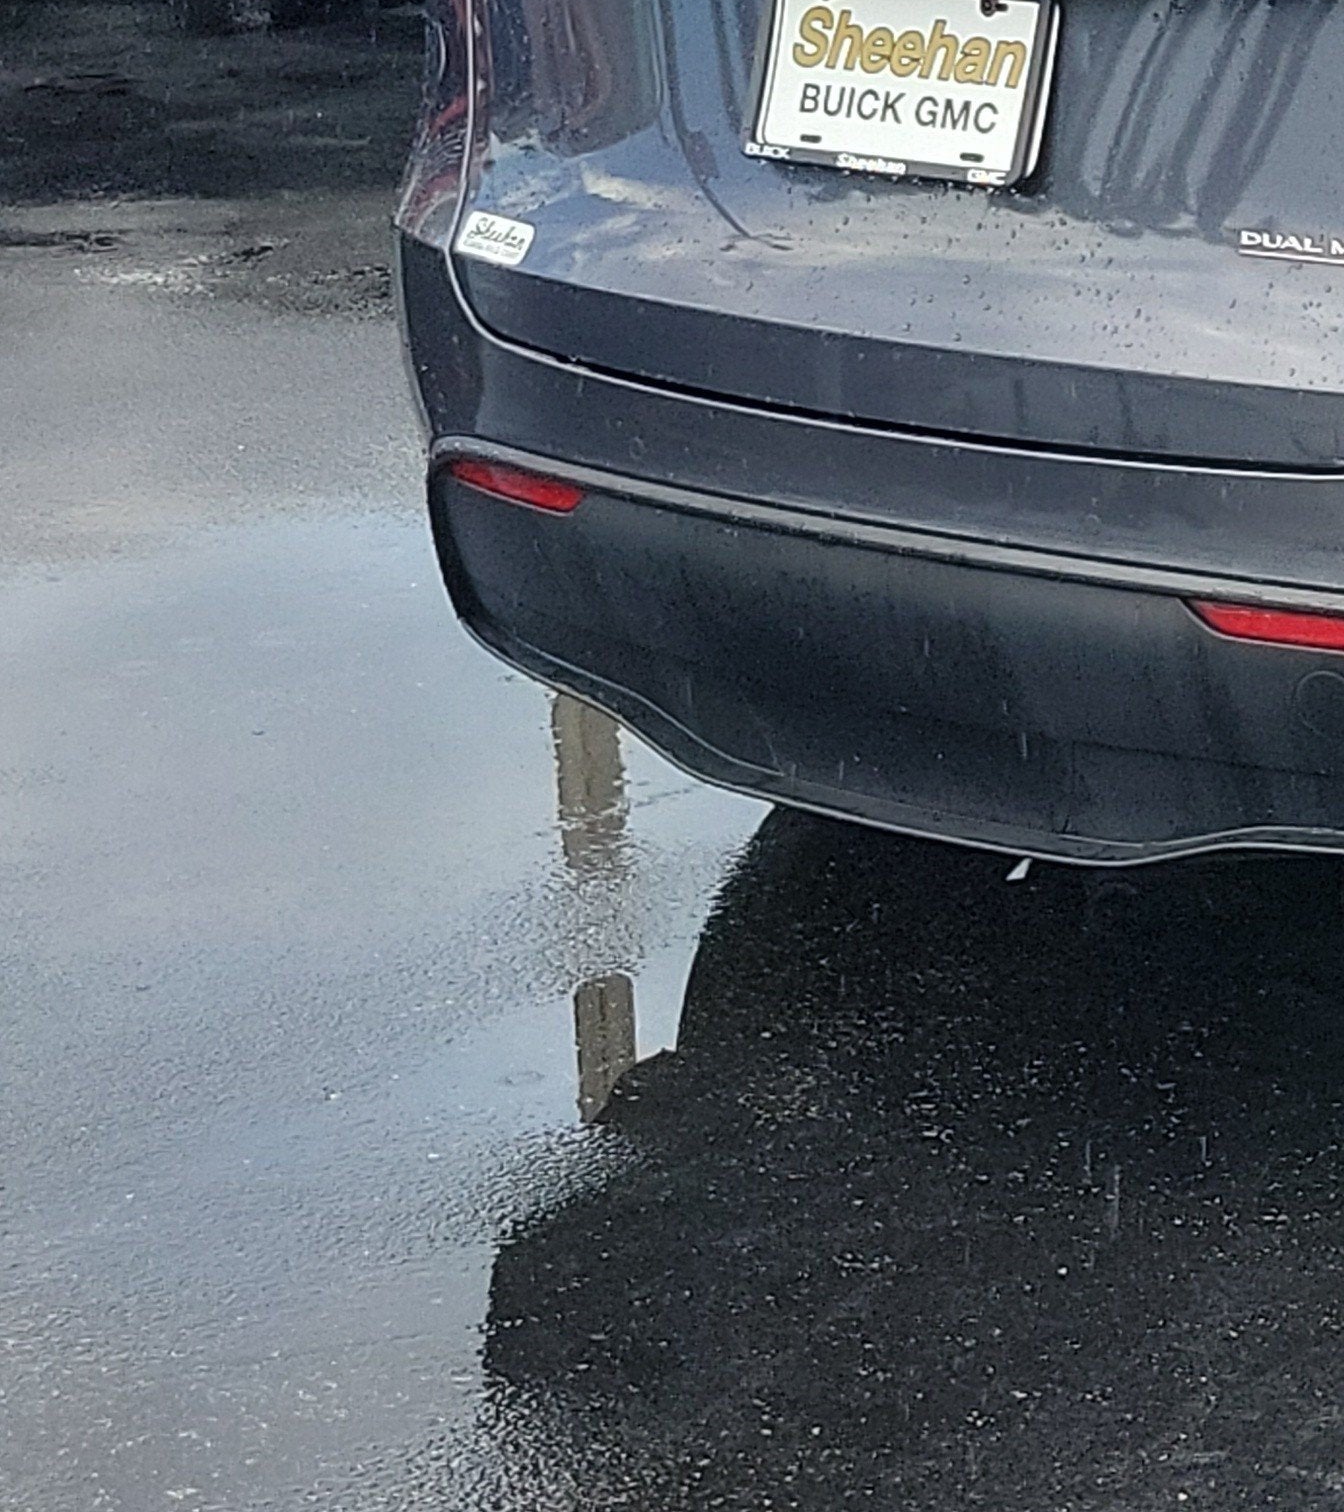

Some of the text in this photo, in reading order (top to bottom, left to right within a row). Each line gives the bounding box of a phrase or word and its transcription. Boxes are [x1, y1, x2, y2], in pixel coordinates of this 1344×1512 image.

[792, 5, 1027, 90] Sheehan
[799, 82, 999, 134] BUICK GMC
[744, 142, 791, 160] BUICK
[836, 152, 907, 175] Sheehan
[967, 169, 1007, 186] GMC
[1240, 230, 1323, 254] DUAL
